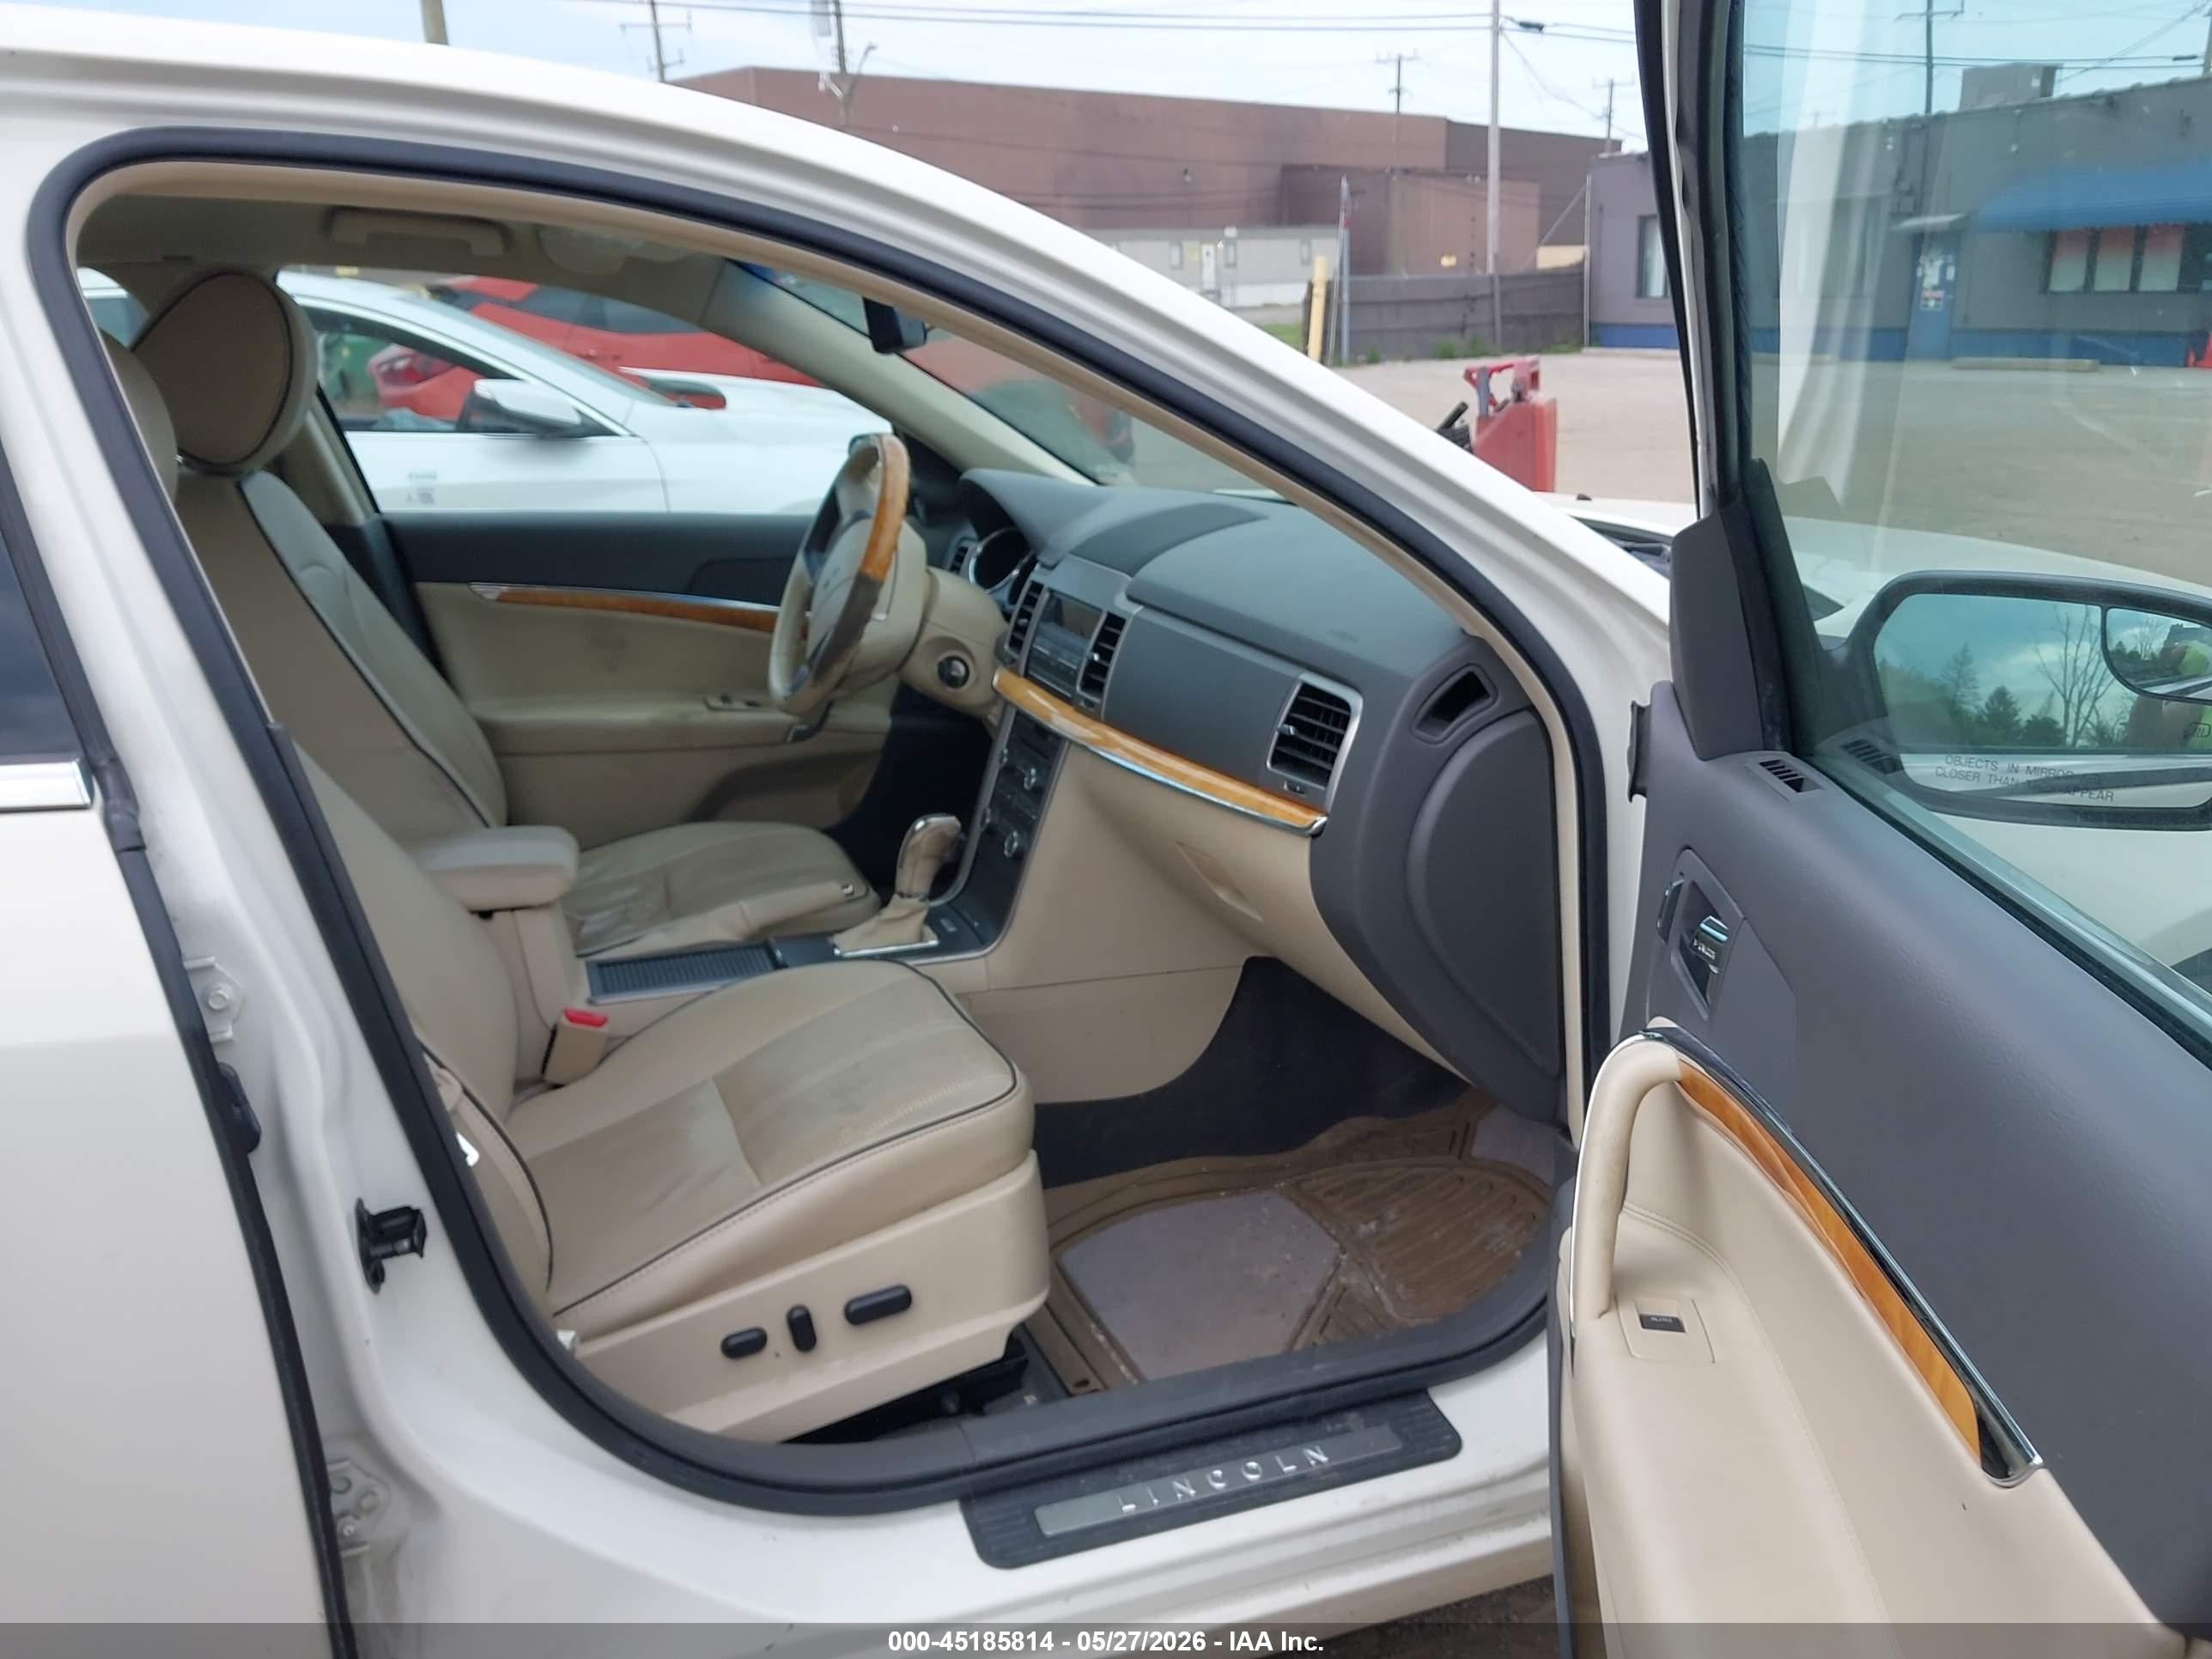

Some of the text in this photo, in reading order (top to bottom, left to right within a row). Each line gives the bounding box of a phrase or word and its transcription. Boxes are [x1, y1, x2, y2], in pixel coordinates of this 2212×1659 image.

[1936, 765, 1980, 782] CLOSER
[1945, 755, 1998, 771] OBJECTS
[2007, 763, 2019, 774] IN
[1116, 1444, 1329, 1513] LINCOLN
